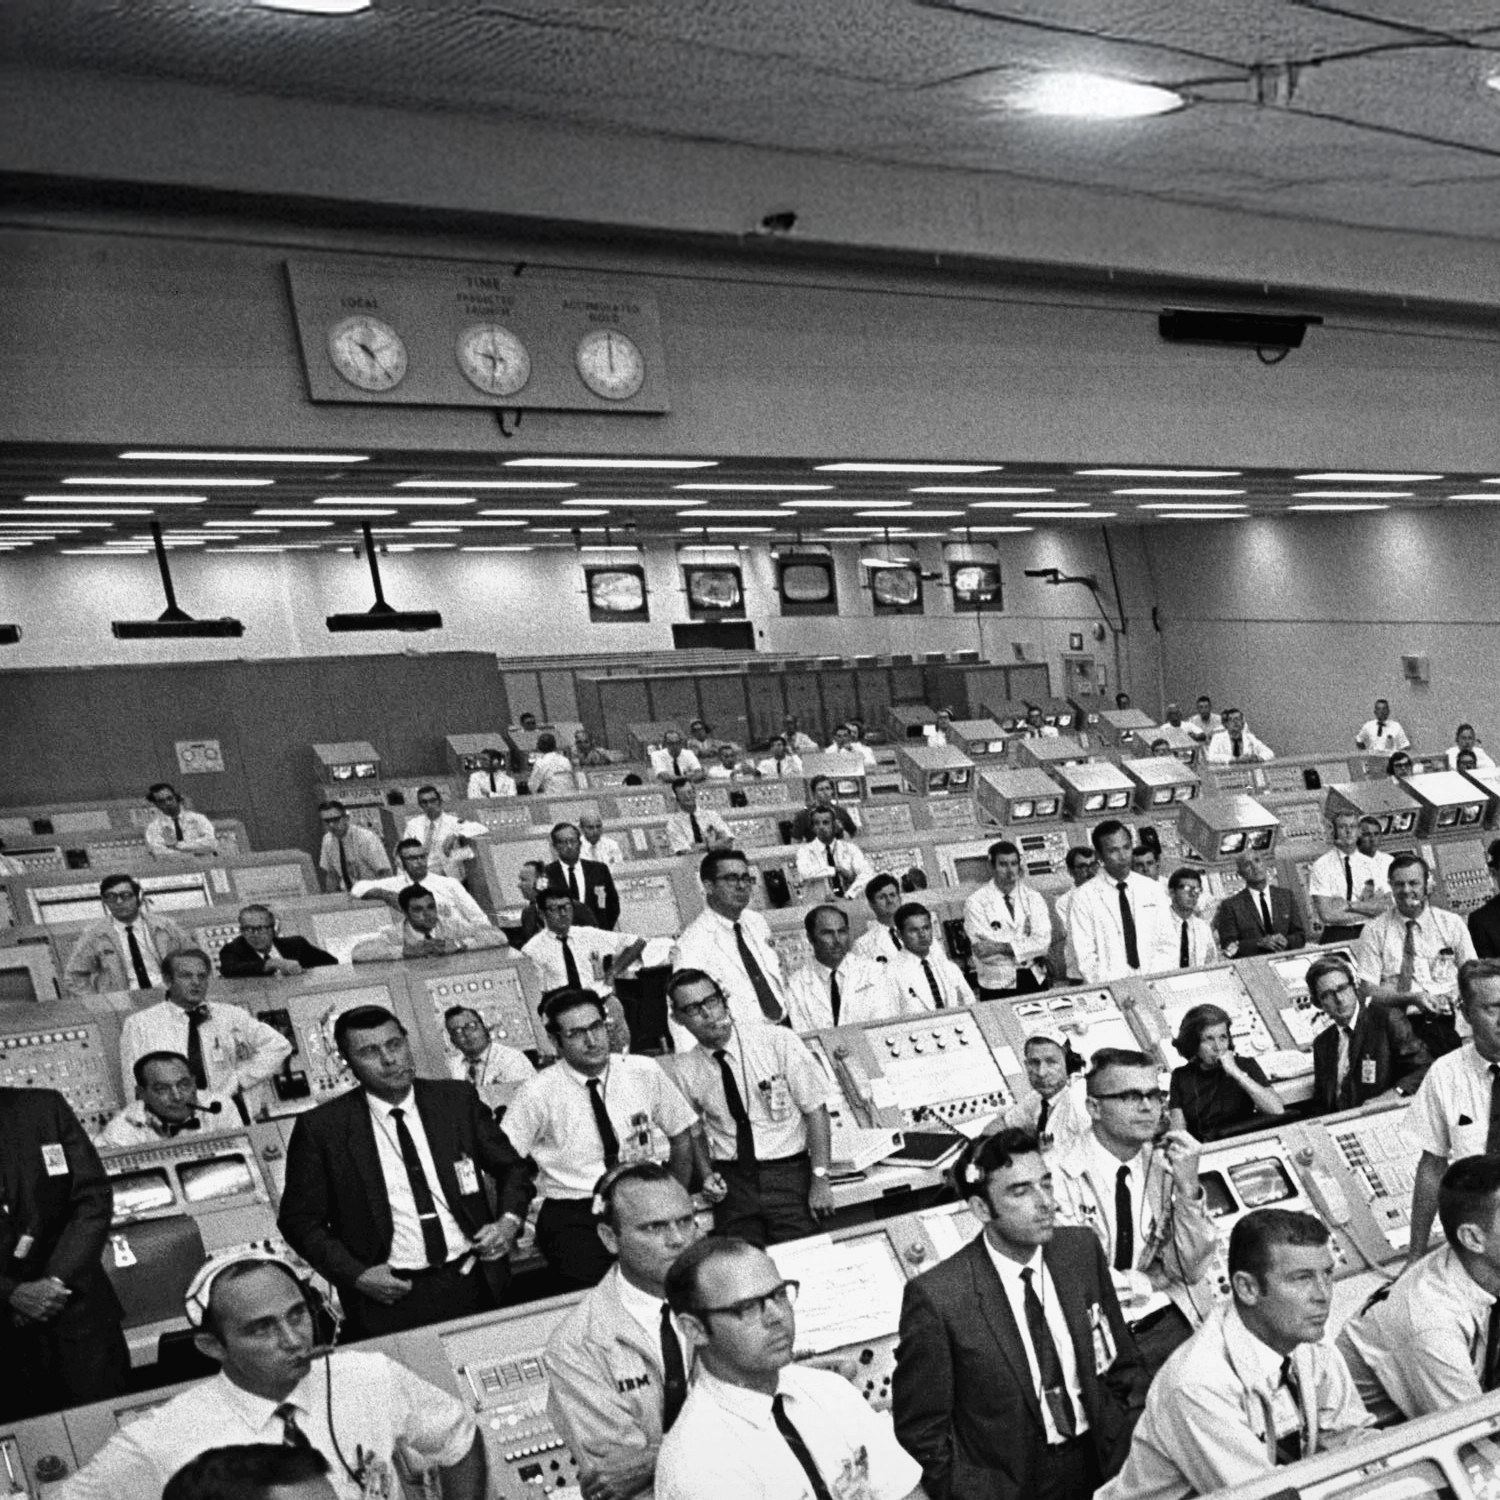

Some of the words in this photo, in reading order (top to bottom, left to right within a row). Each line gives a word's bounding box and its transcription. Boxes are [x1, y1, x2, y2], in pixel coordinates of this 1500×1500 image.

[463, 276, 501, 291] TIME
[340, 296, 379, 308] LOCAL
[589, 312, 620, 325] HOLD
[618, 1374, 650, 1393] IBM
